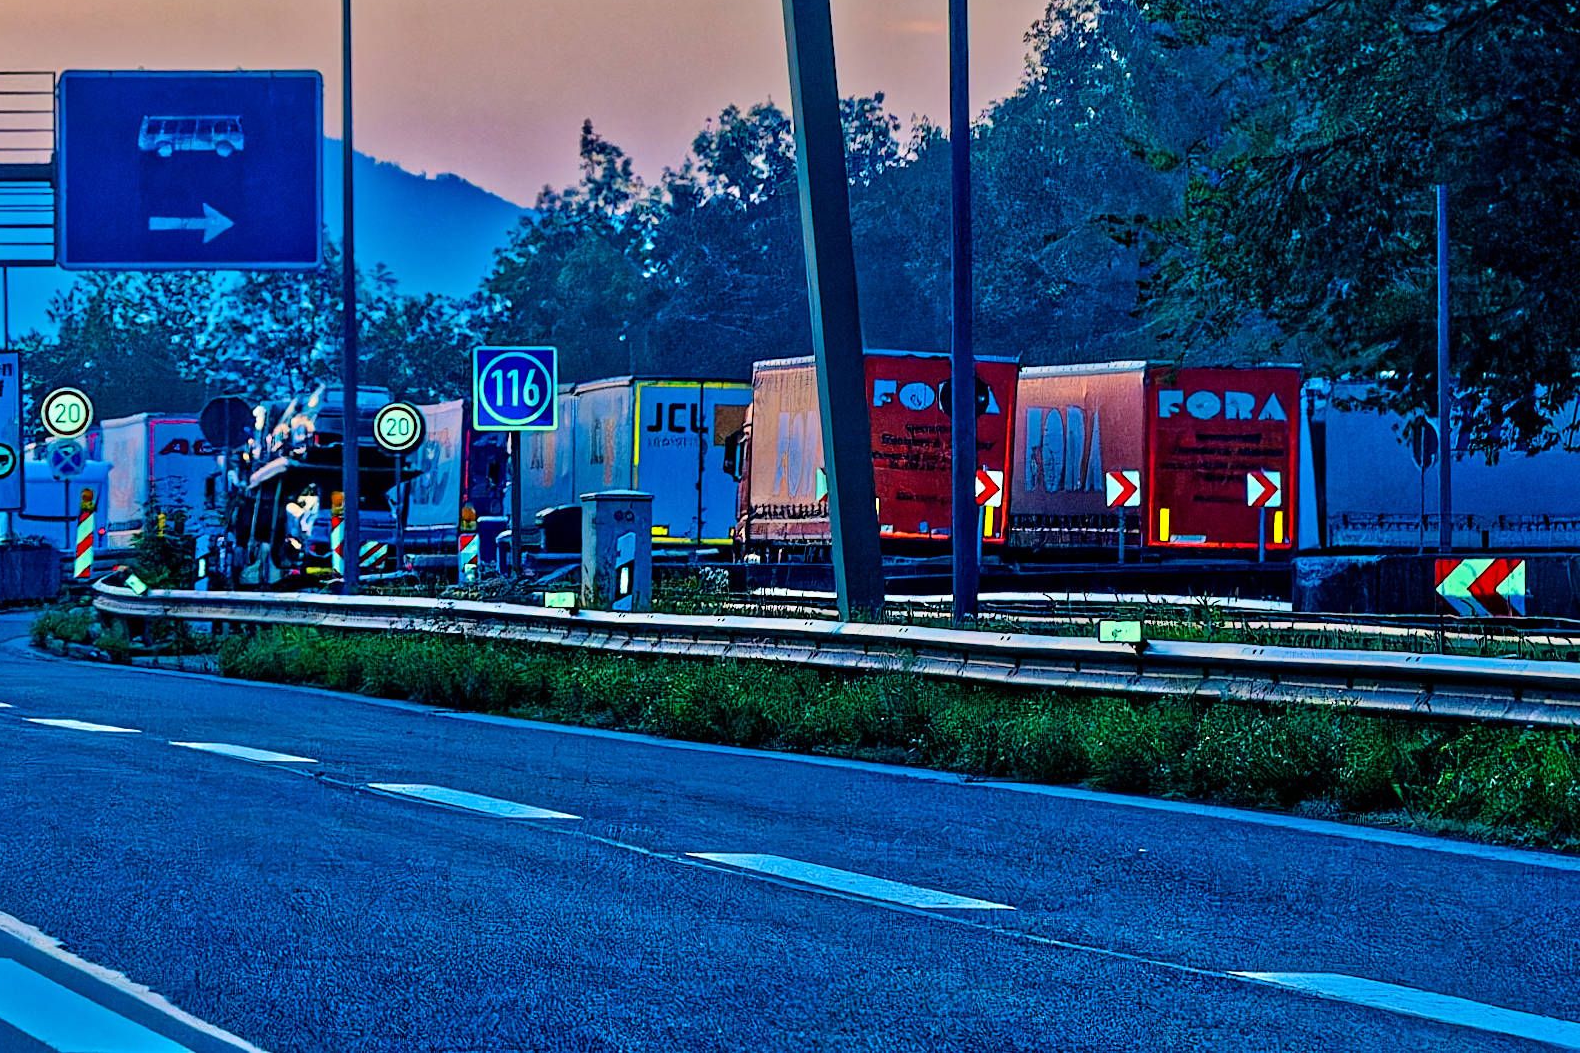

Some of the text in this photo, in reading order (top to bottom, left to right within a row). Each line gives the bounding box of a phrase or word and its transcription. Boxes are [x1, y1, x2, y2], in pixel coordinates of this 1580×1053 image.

[490, 368, 540, 407] 116
[54, 403, 81, 424] 20
[646, 402, 709, 434] JCL
[1158, 389, 1288, 421] FORA
[385, 417, 410, 437] 20
